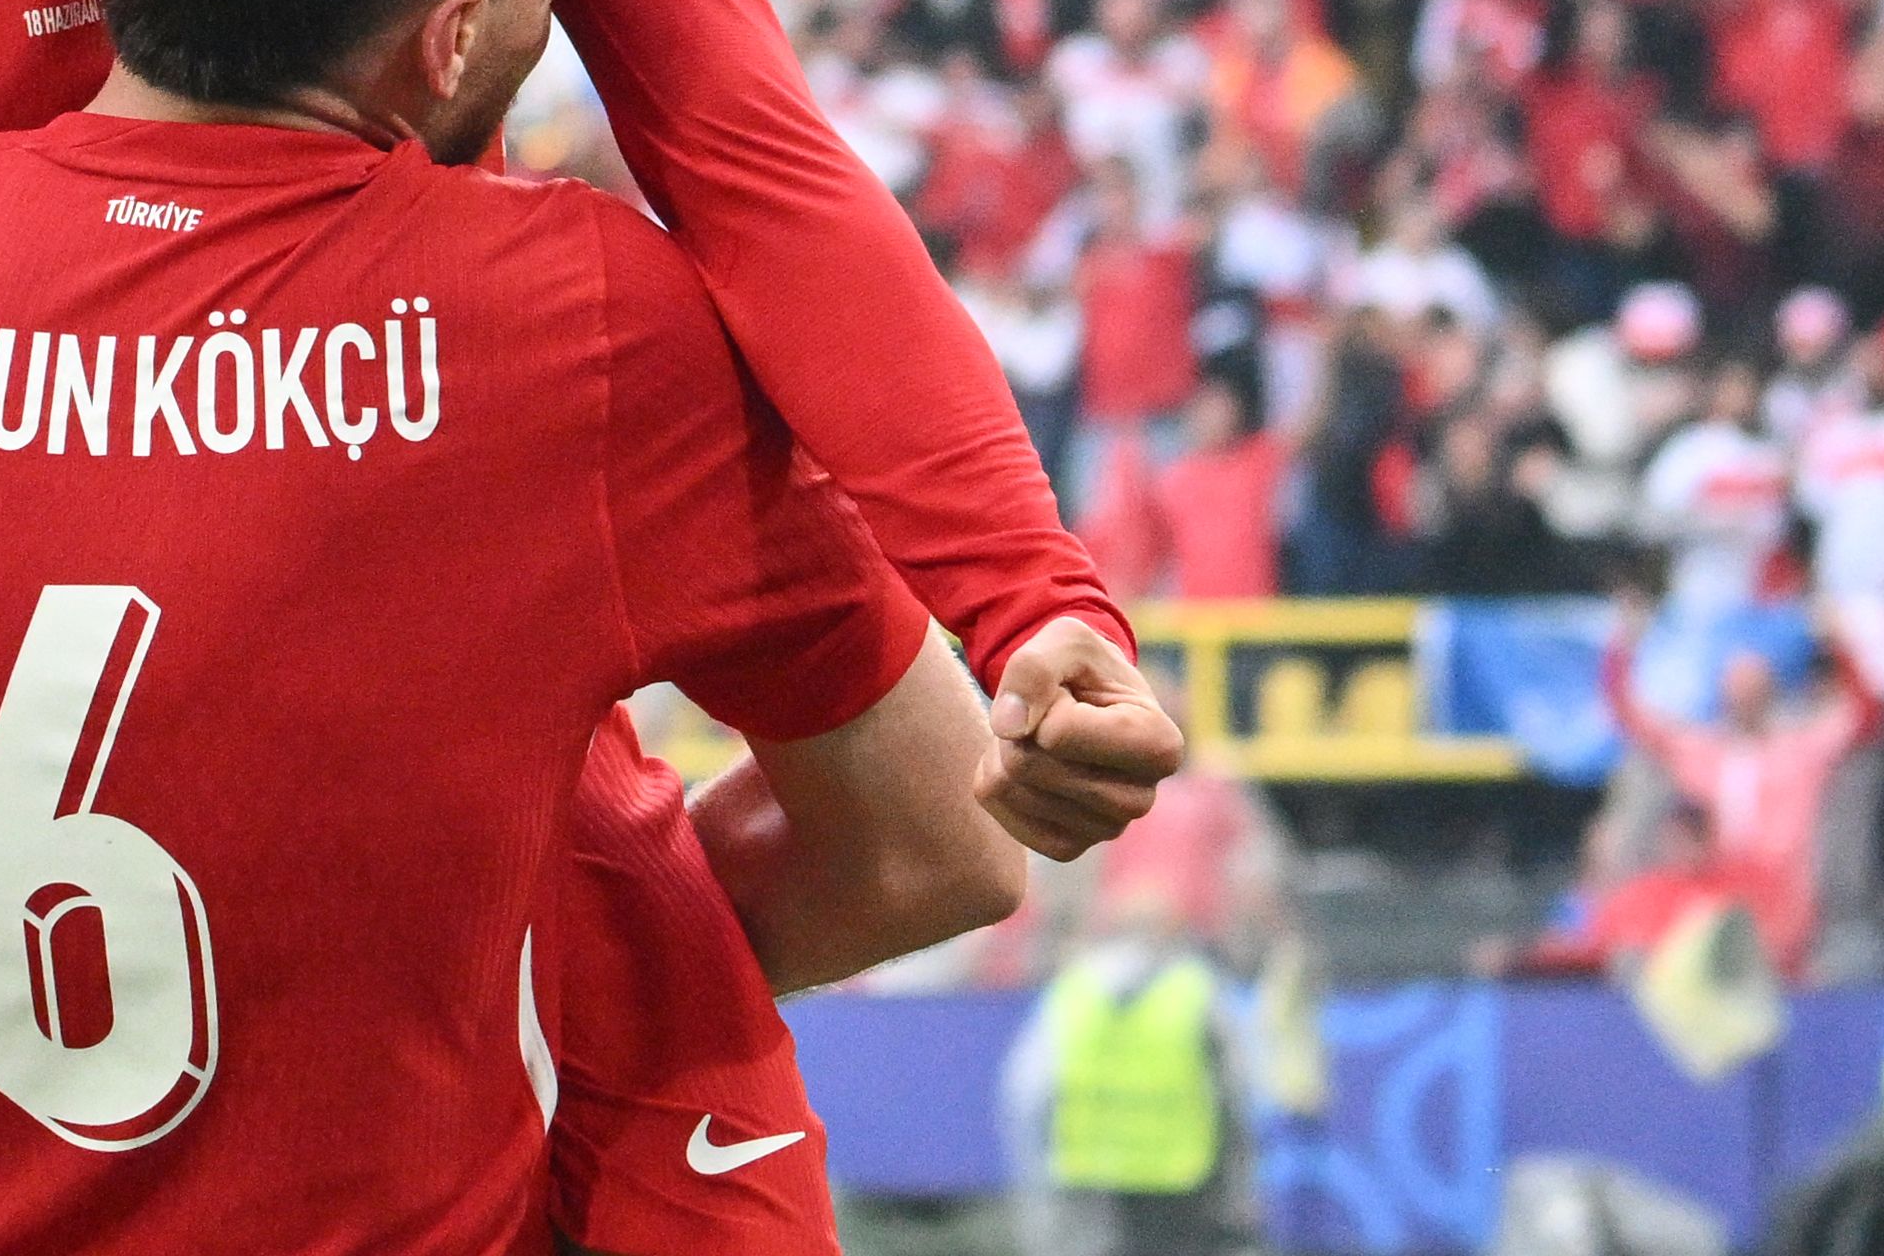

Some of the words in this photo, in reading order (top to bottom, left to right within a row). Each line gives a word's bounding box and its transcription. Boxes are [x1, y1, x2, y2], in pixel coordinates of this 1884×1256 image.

[23, 8, 43, 38] 18
[104, 195, 204, 232] TÜRKİYE
[132, 296, 440, 461] KÖKÇÜ
